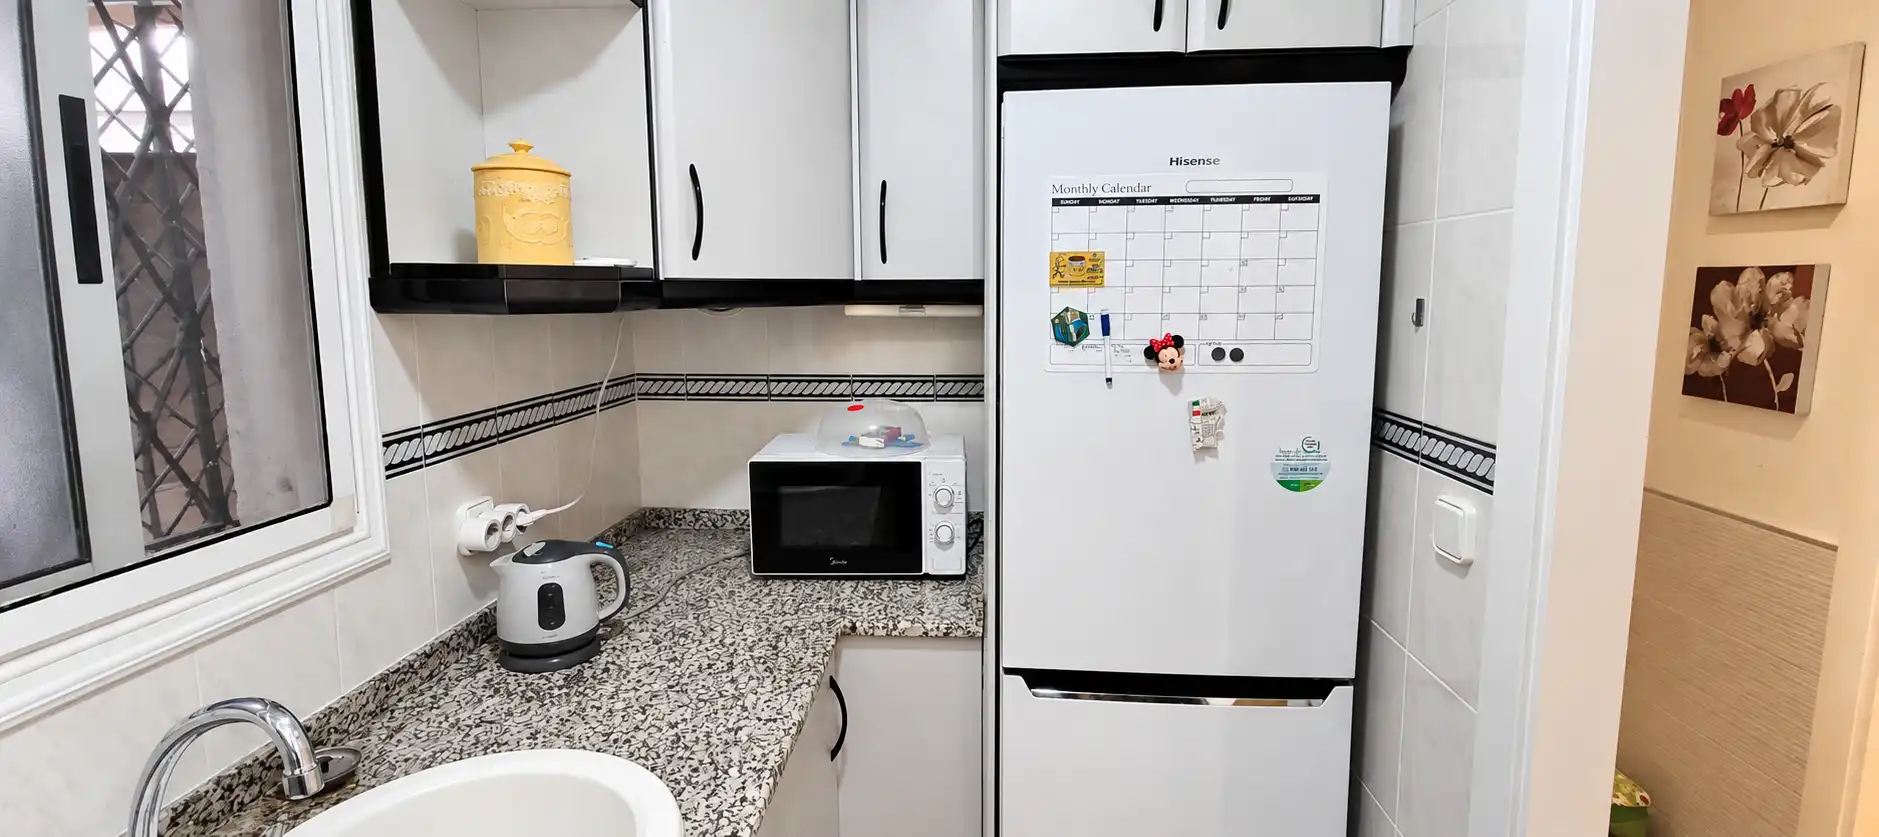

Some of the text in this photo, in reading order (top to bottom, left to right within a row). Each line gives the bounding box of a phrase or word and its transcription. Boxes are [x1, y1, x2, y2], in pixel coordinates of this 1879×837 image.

[1169, 156, 1221, 166] Hisense
[1052, 182, 1152, 196] Monthly Calendar
